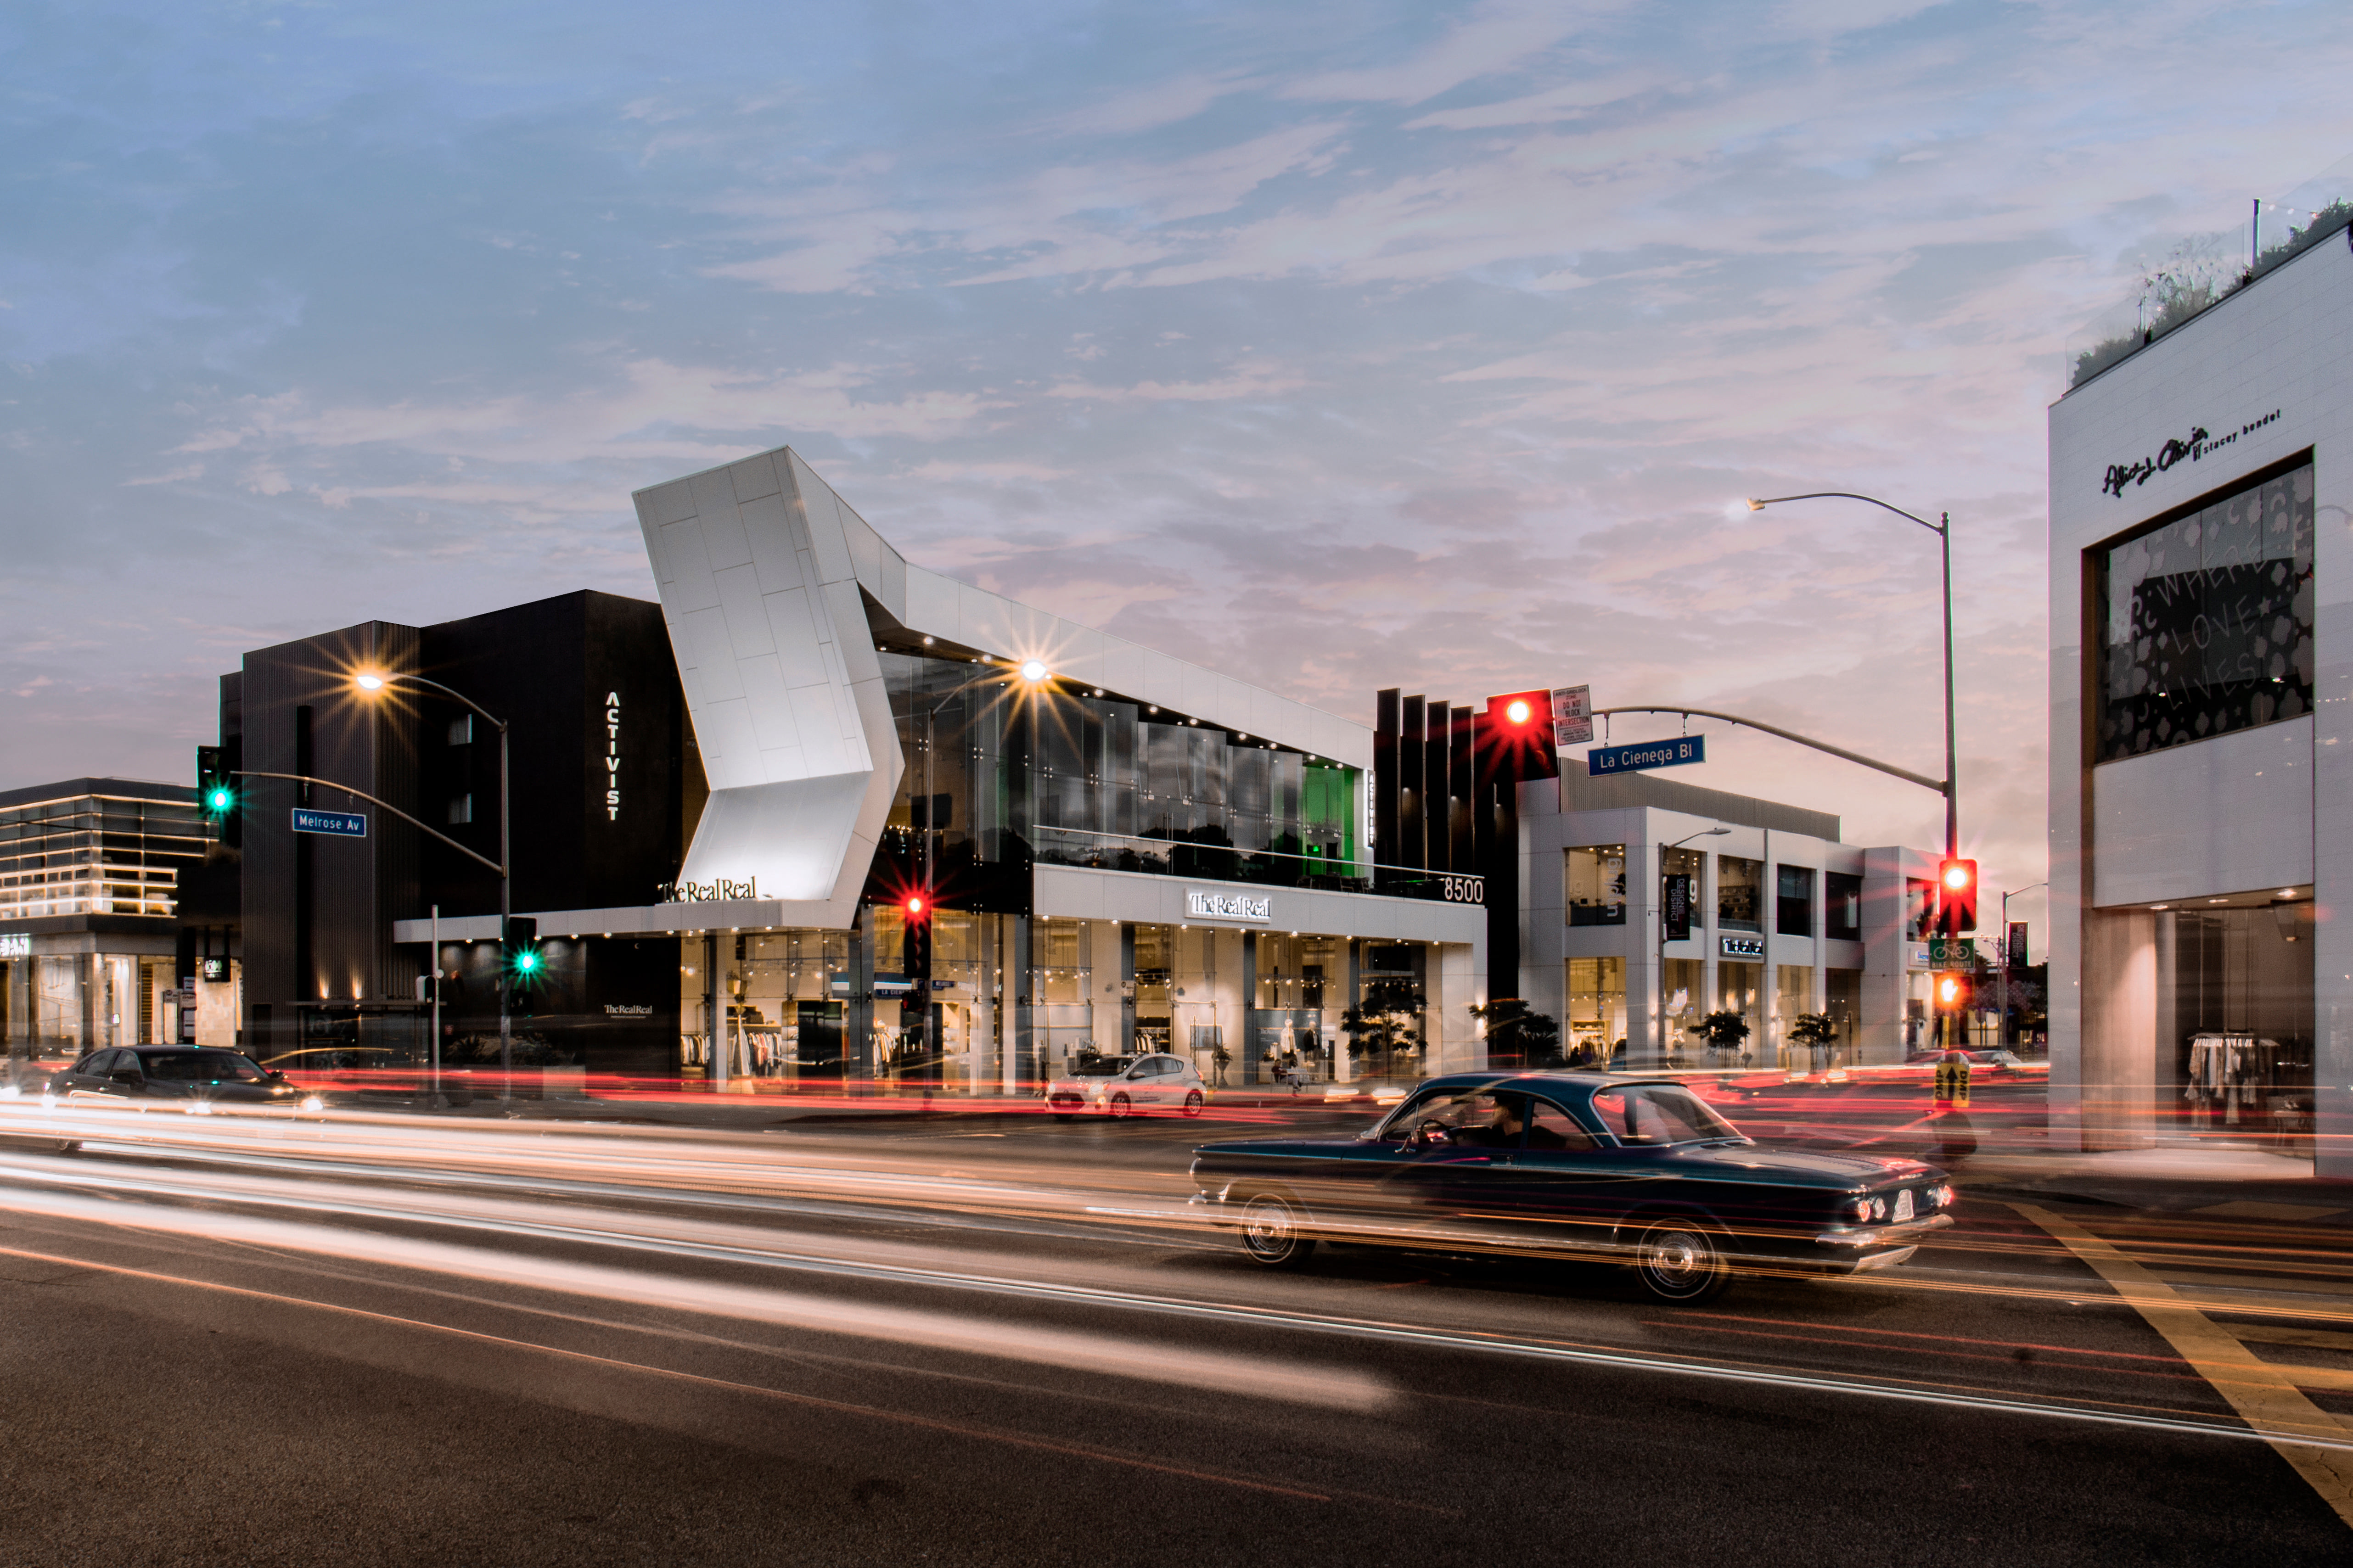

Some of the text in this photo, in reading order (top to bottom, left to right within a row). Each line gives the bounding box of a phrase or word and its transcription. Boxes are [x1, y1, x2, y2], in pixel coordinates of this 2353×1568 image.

[2203, 431, 2238, 454] stacey
[2243, 409, 2281, 436] bendet
[2172, 595, 2256, 655] LOVE
[2164, 653, 2256, 711] LIVES
[1558, 716, 1589, 727] INTERSECTION
[1565, 709, 1580, 717] BLOCK
[606, 692, 620, 820] ACTIVIST
[1600, 755, 1614, 768] La
[1622, 748, 1673, 765] Cienega
[299, 814, 359, 830] Melrose Av
[1444, 876, 1483, 903] 8500
[1605, 857, 1622, 917] unplug
[1959, 1070, 1968, 1100] DMP
